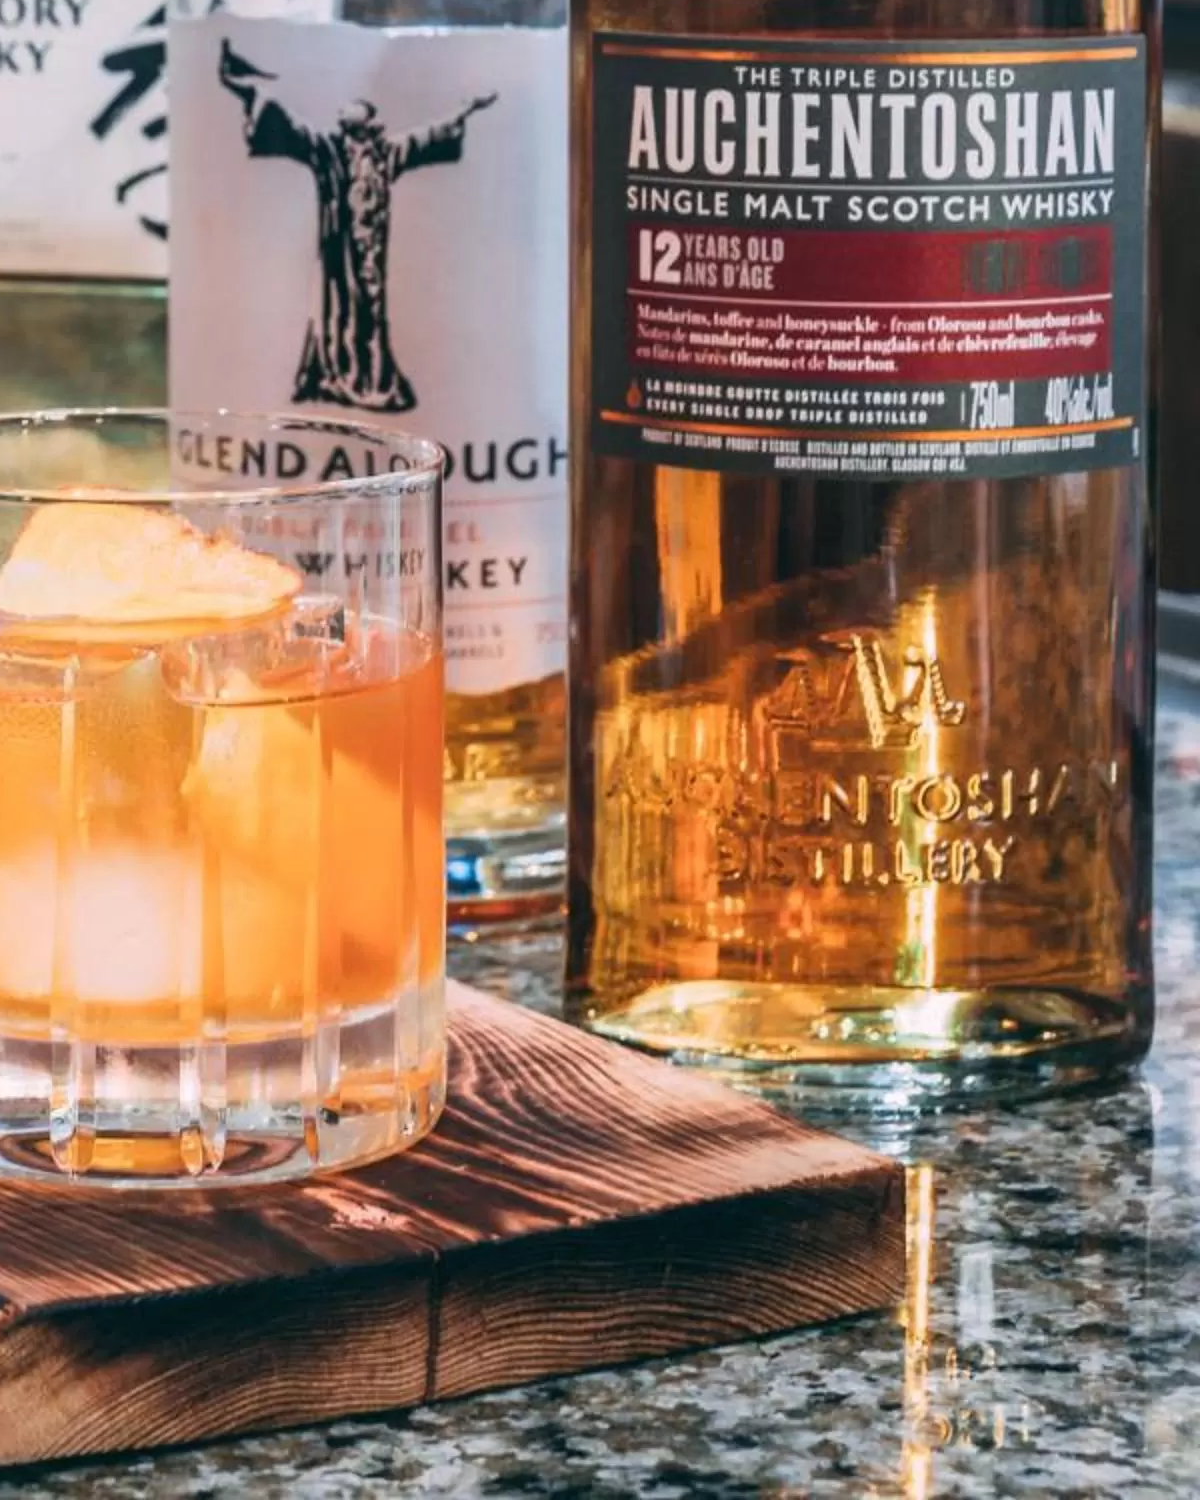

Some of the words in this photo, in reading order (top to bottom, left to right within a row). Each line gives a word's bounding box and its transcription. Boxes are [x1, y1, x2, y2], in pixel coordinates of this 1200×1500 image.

[733, 66, 781, 87] THE
[791, 67, 876, 88] TRIPLE
[888, 68, 1016, 89] DISTILLED
[627, 85, 1115, 181] AUCHENTOSHAN
[626, 184, 729, 217] SINGLE
[743, 193, 833, 221] MALT
[847, 195, 990, 222] SCOTCH
[1001, 188, 1115, 219] WHISKY
[639, 228, 682, 285] 12
[683, 233, 741, 260] YEARS
[747, 236, 785, 262] OLD
[683, 261, 718, 288] ANS
[755, 314, 782, 331] and
[889, 315, 925, 333] from
[789, 408, 843, 424] TRIPLE
[849, 410, 929, 425] DISTILLED
[969, 380, 1015, 430] 750ml
